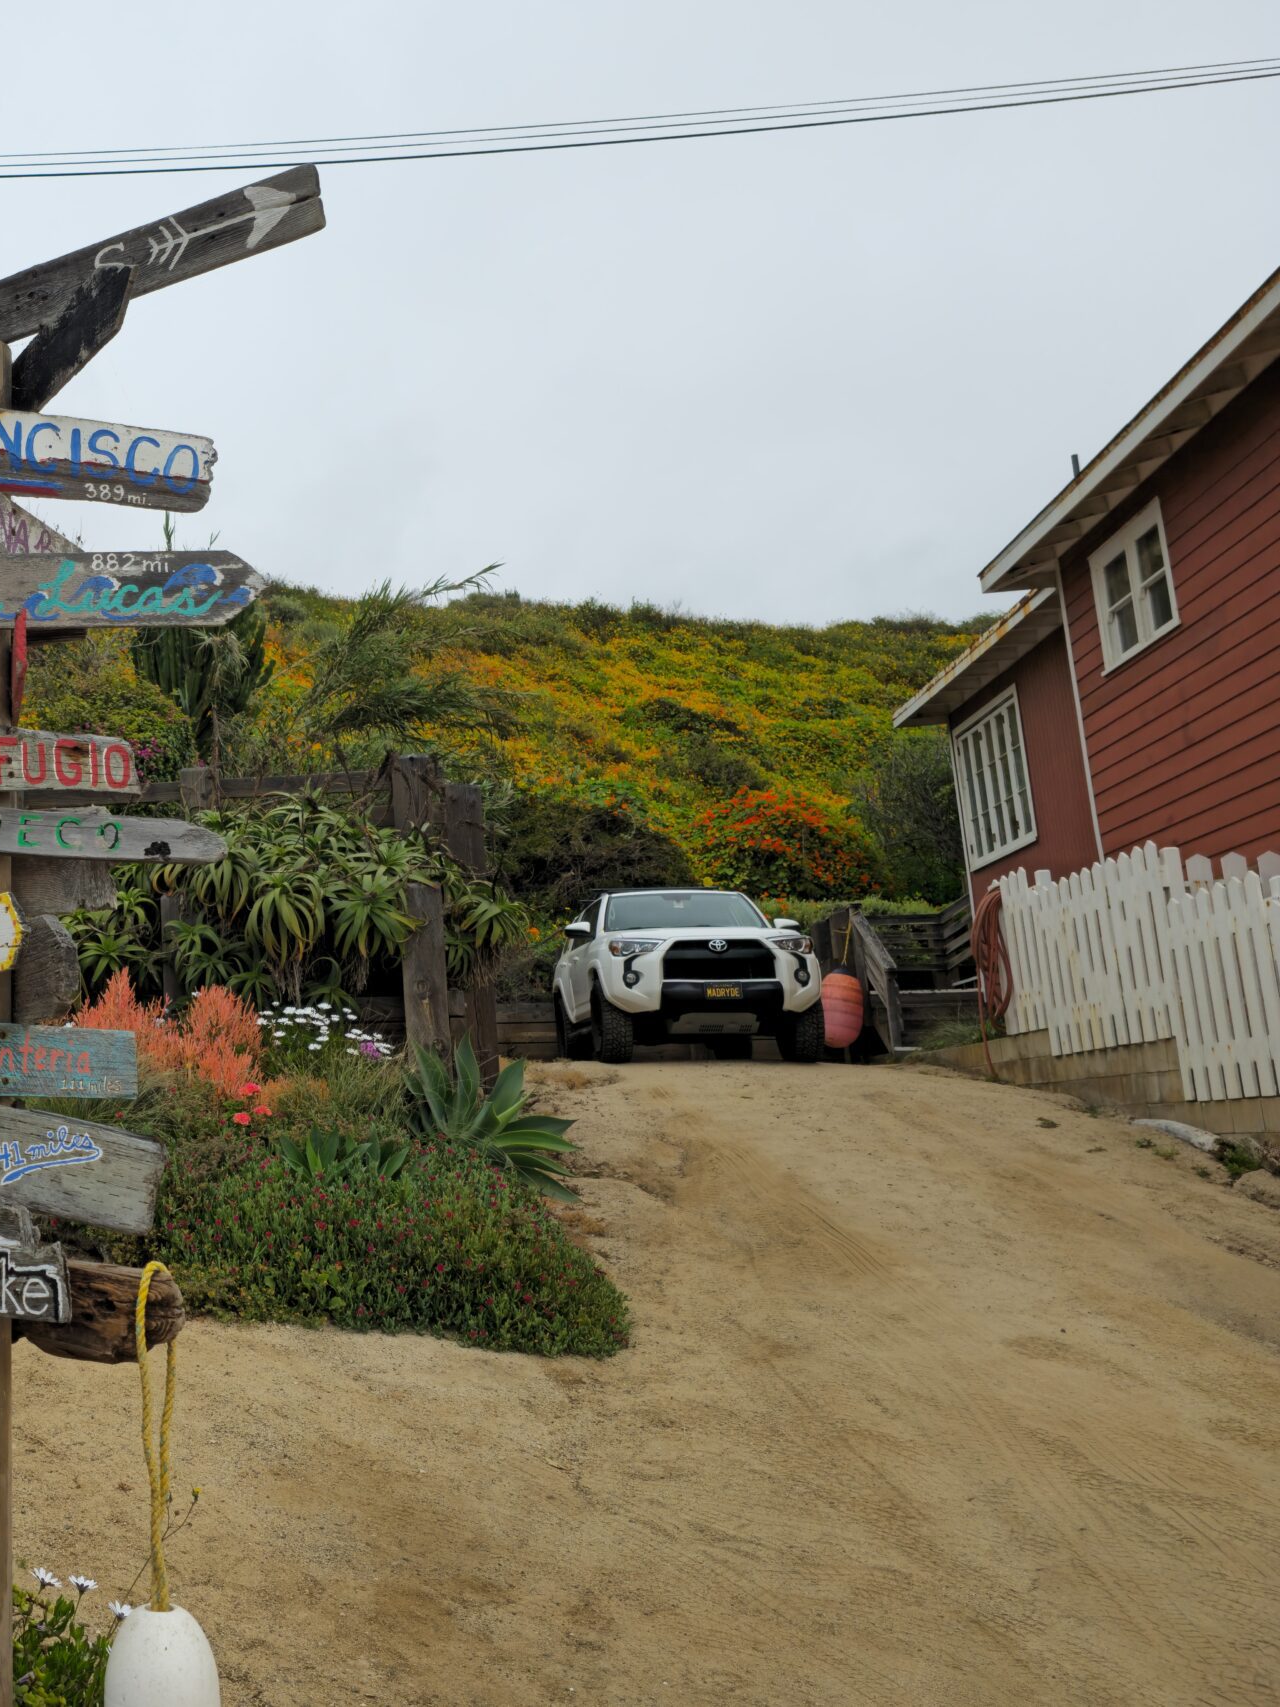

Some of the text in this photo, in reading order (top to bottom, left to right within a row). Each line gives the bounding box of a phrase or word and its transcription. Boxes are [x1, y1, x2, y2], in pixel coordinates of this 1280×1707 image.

[83, 482, 125, 502] 389
[91, 553, 135, 572] 882
[34, 559, 225, 617] Lucas
[88, 1075, 121, 1094] miles
[24, 1124, 95, 1161] miles
